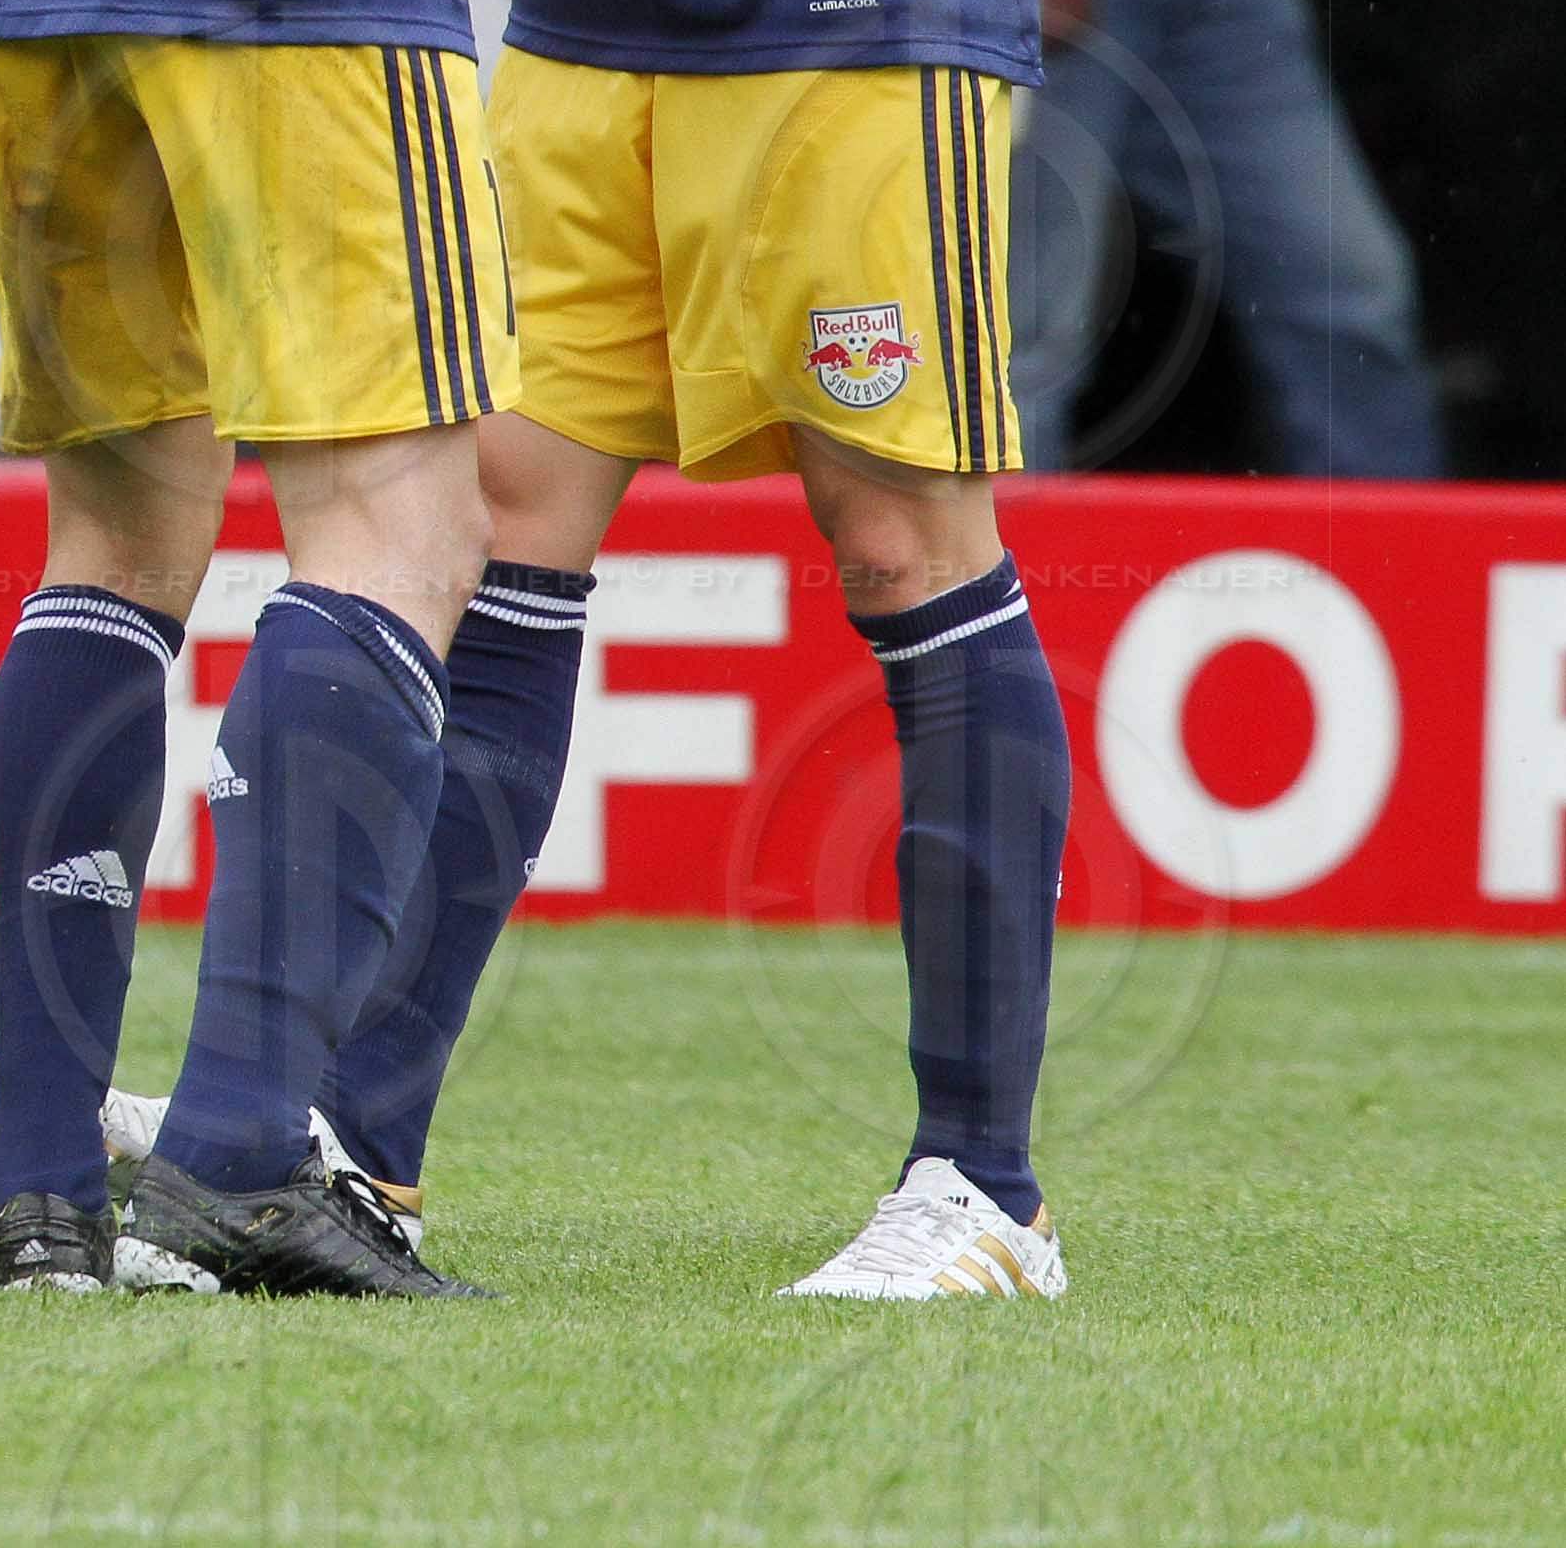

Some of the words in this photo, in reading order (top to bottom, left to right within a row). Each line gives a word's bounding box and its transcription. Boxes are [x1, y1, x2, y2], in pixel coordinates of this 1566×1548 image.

[816, 316, 853, 334] Red
[858, 310, 895, 331] Bull
[827, 369, 899, 402] SALZBURG
[27, 874, 133, 909] adidas
